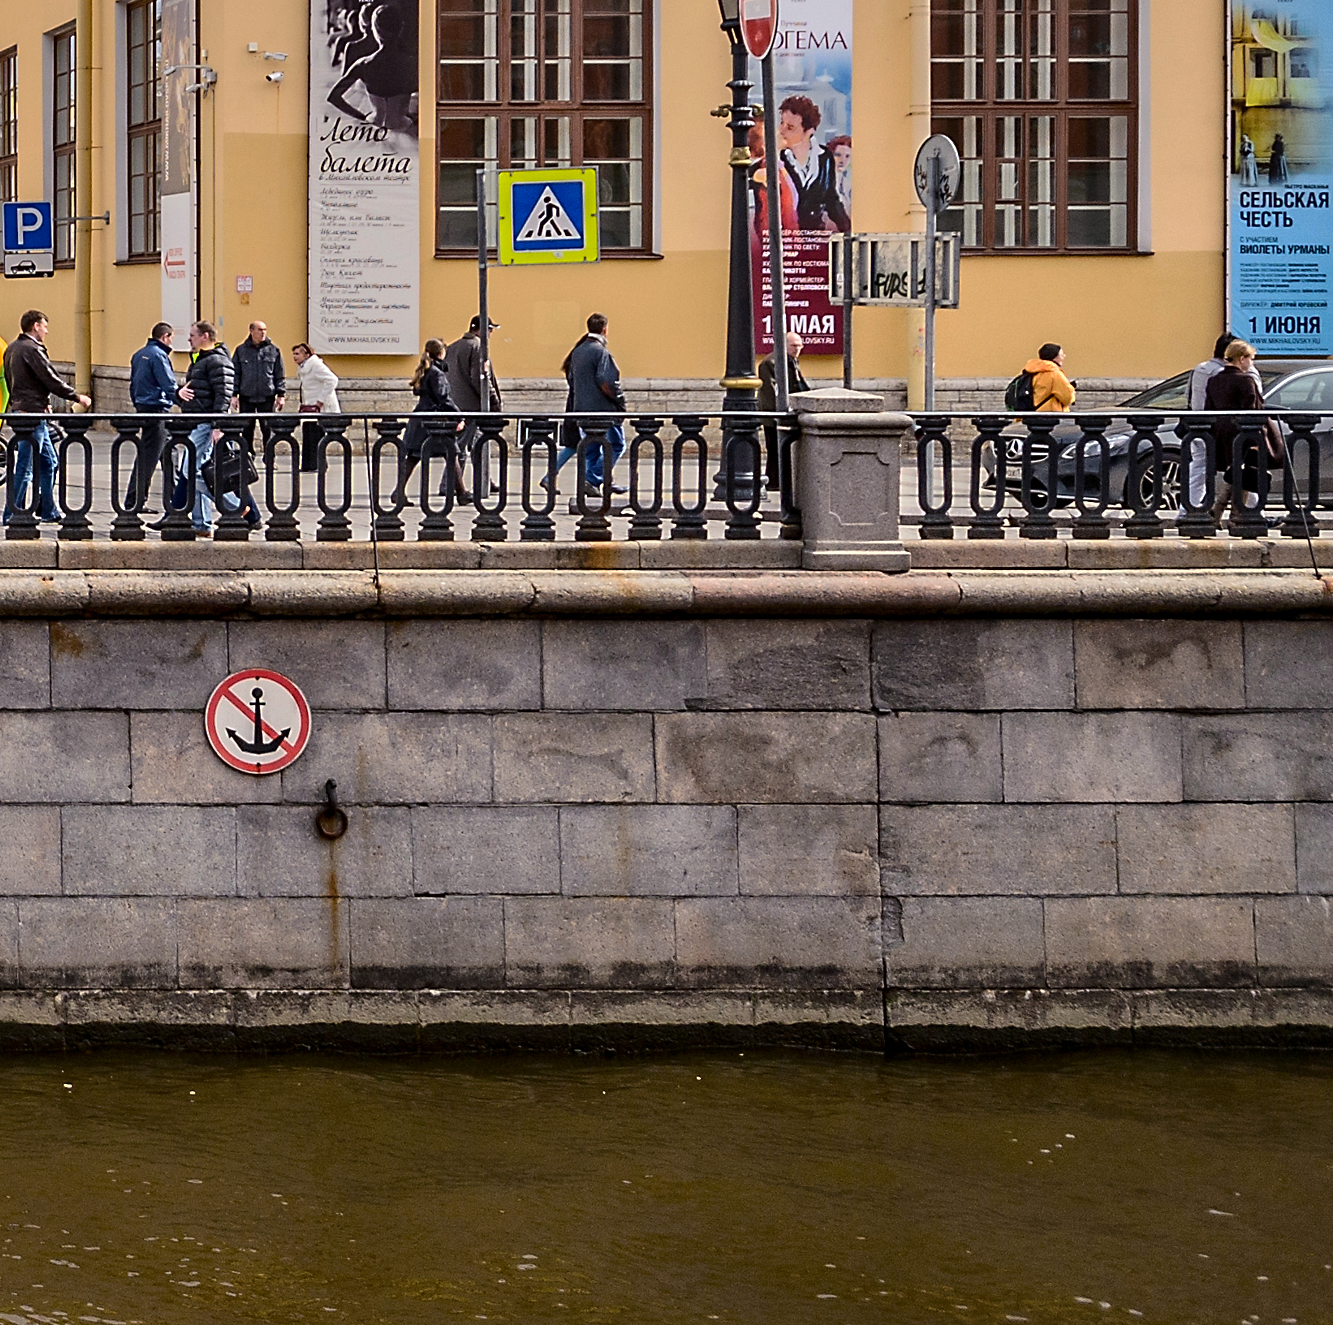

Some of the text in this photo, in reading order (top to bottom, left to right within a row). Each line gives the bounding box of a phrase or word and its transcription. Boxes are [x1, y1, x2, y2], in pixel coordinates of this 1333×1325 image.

[773, 30, 848, 50] ОГЕМА
[320, 115, 388, 142] Лето
[320, 141, 413, 174] балета
[1239, 191, 1329, 208] СЕЛЬСКАЯ
[17, 208, 43, 245] P
[1239, 211, 1294, 228] ЧЕСТЬ
[1239, 245, 1330, 254] ВИОЛЕТЫ УРМАНЫ
[790, 315, 835, 333] МАЯ
[1248, 317, 1320, 333] 1 ИЮНЯ
